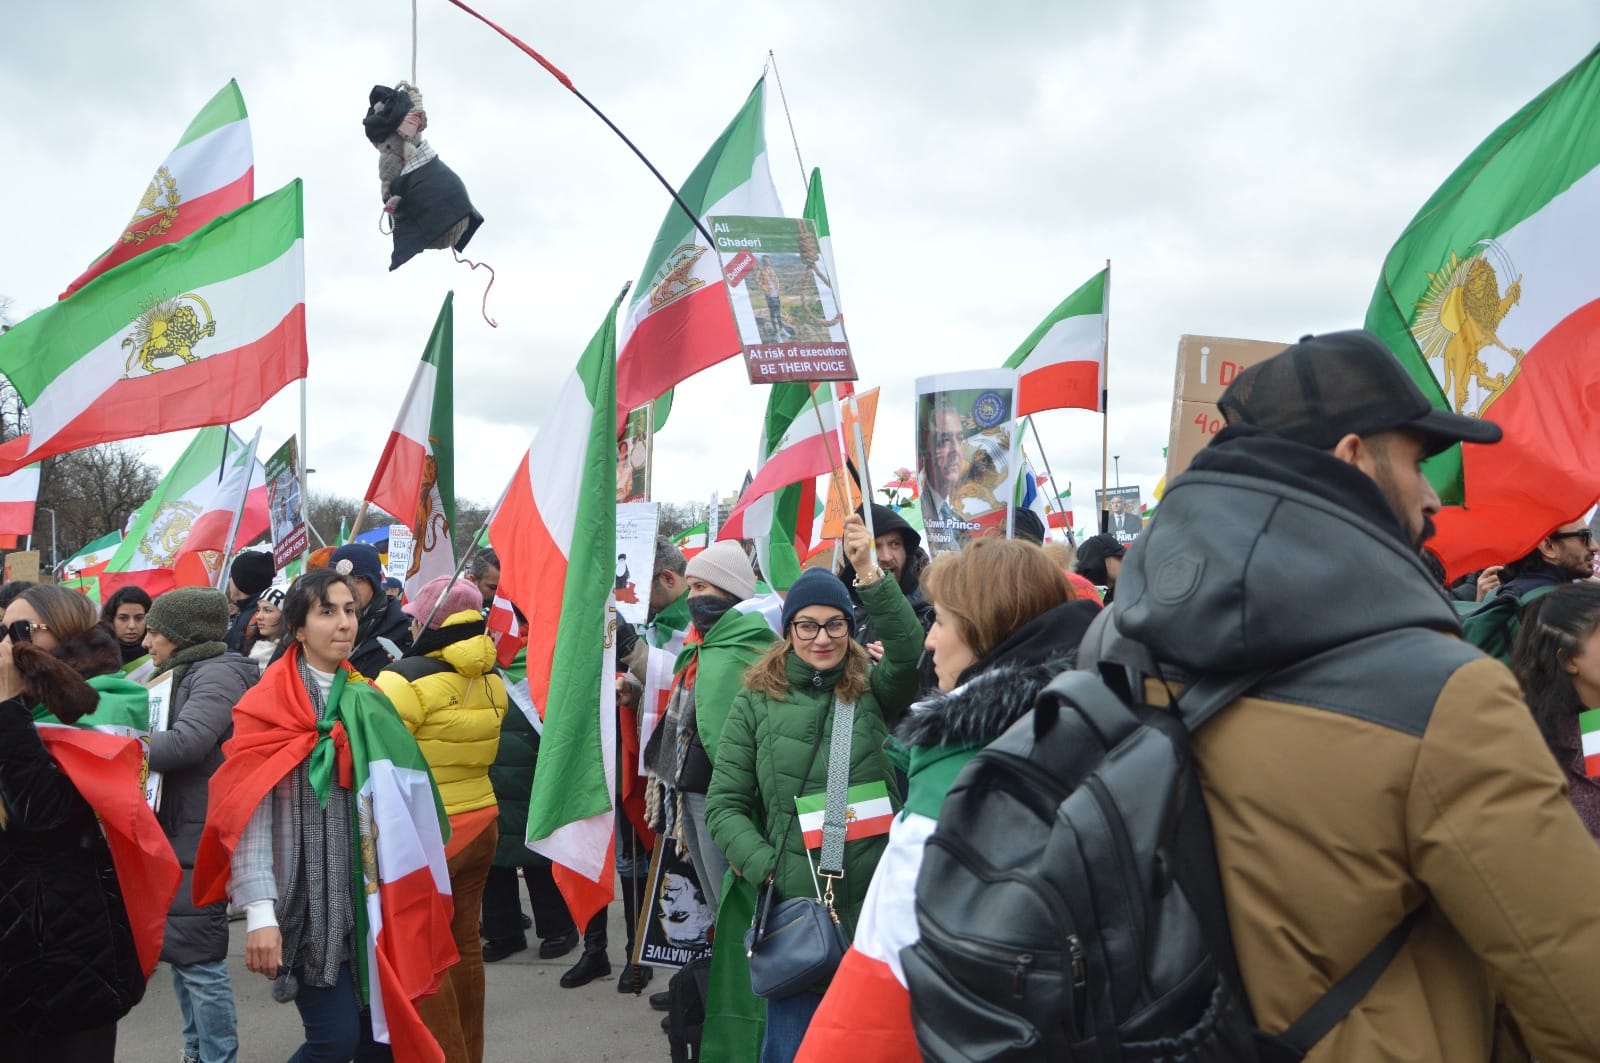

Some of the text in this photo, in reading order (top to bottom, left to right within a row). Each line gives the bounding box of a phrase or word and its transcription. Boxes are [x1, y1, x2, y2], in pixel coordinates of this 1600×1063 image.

[714, 223, 730, 233] Ali
[718, 237, 762, 248] Ghaderi
[727, 254, 752, 281] Detained
[750, 345, 848, 360] At risk of execution
[760, 361, 846, 375] BE THEIR VOICE
[1194, 413, 1228, 435] 40
[946, 519, 981, 530] Prince
